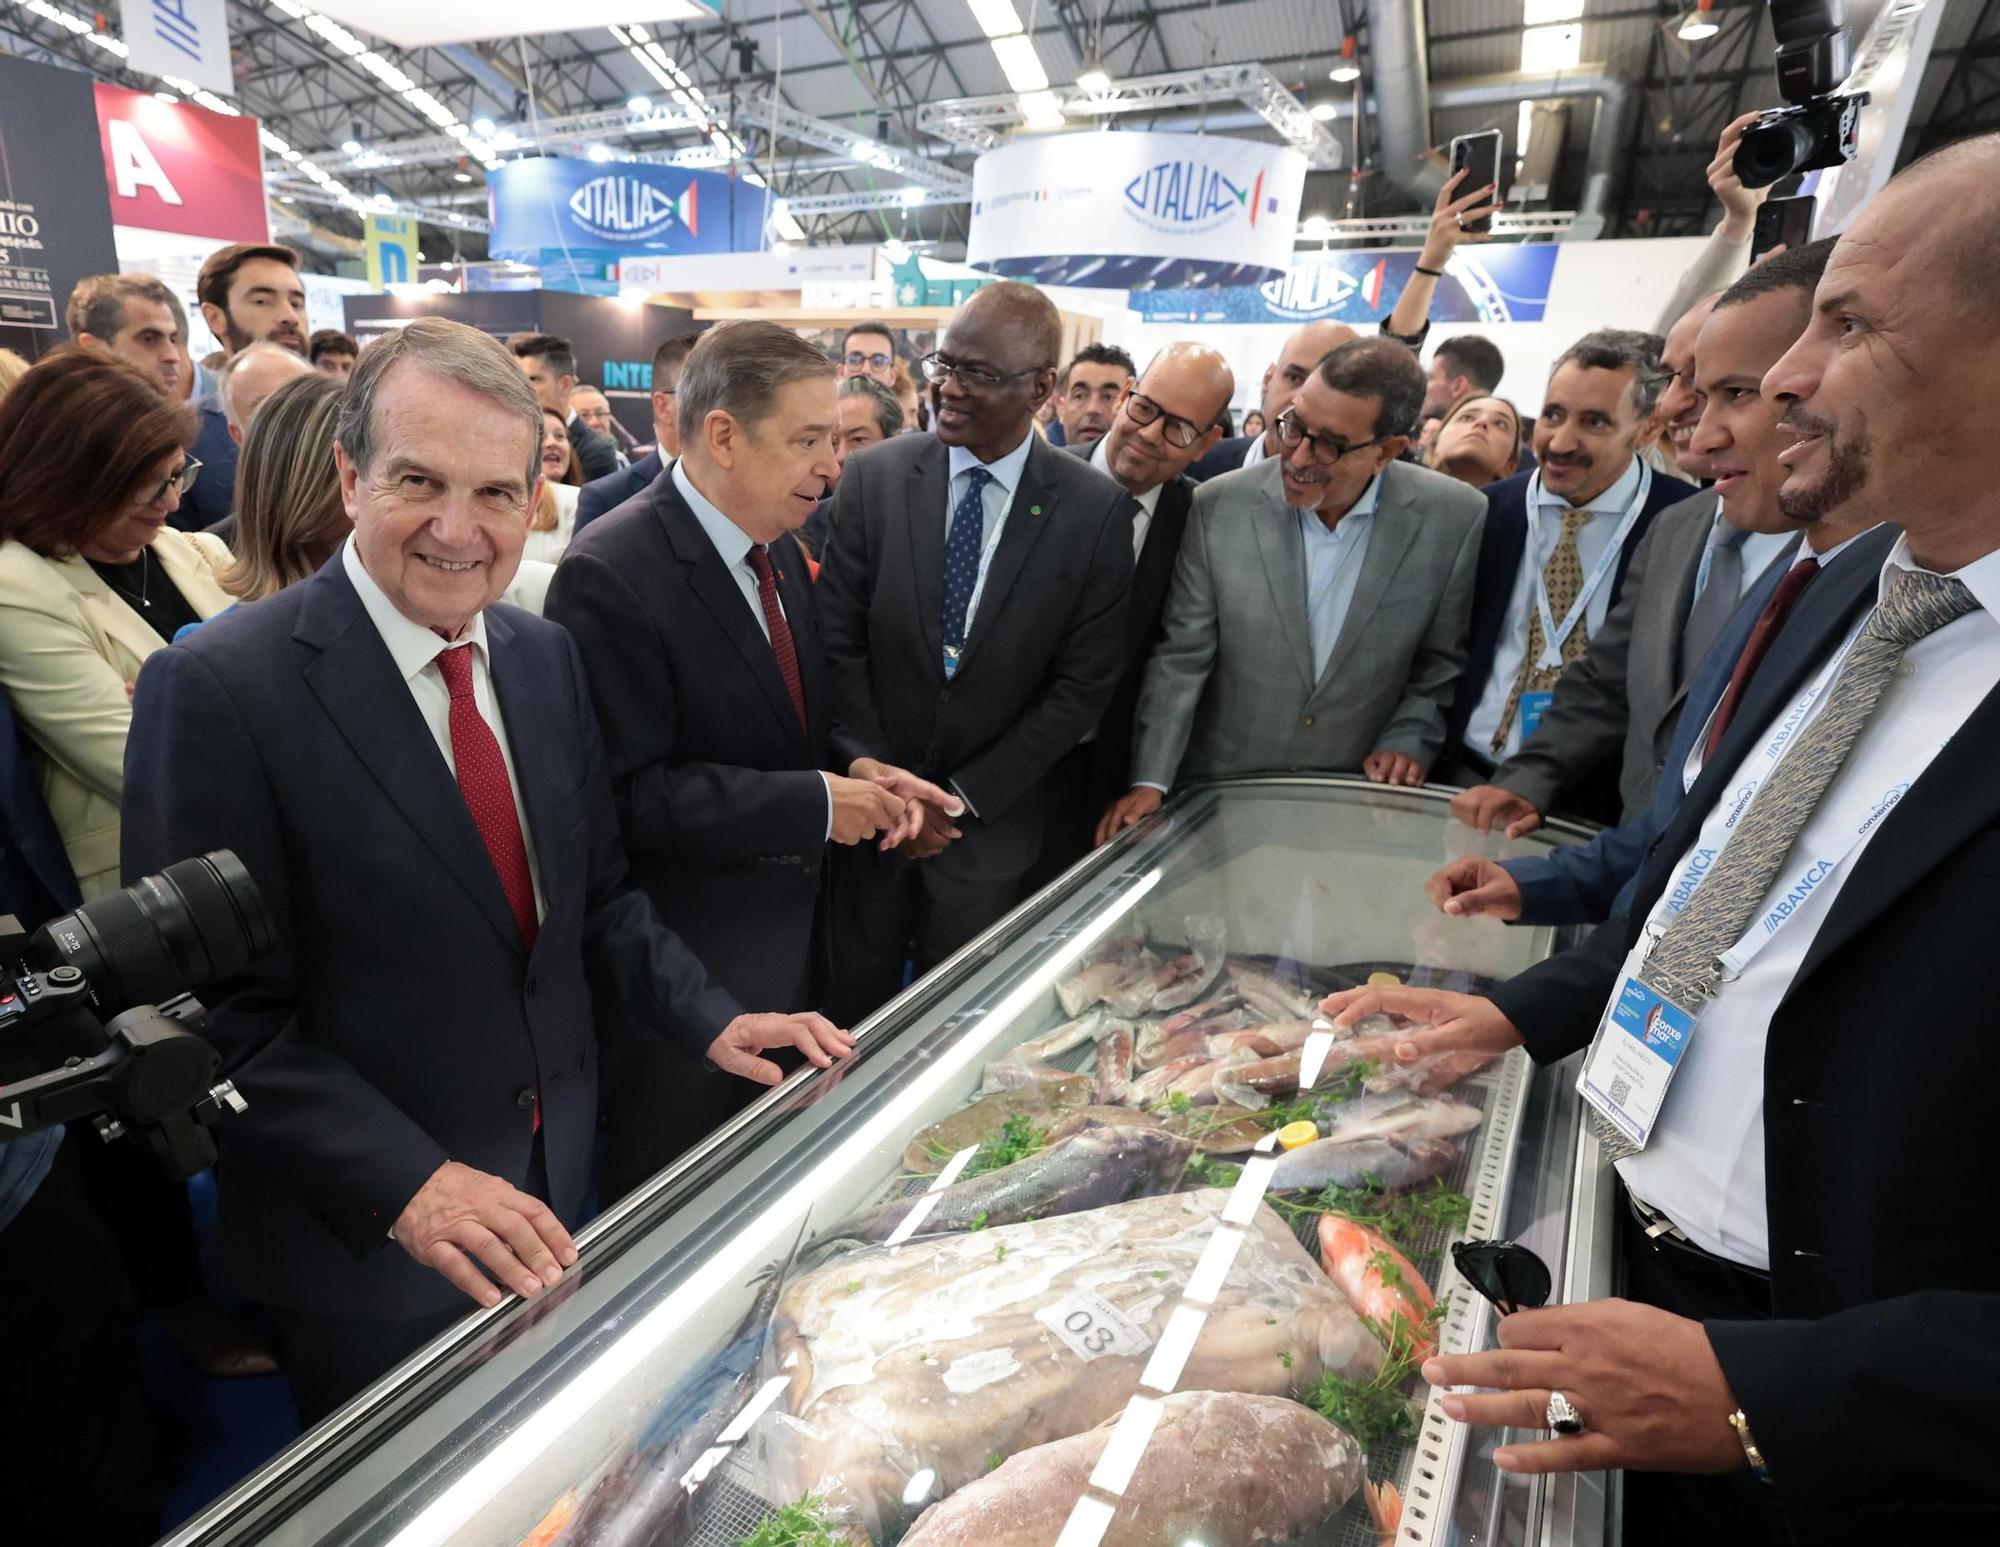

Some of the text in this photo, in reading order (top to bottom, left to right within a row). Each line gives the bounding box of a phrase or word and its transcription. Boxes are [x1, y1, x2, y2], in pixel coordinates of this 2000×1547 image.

[108, 119, 183, 206] A
[569, 176, 674, 230] ITALIA
[1124, 161, 1237, 222] ITALIA
[604, 361, 653, 390] INTE
[1651, 1026, 1671, 1043] mar
[1655, 1017, 1682, 1041] conxe
[1065, 1311, 1114, 1352] 03
